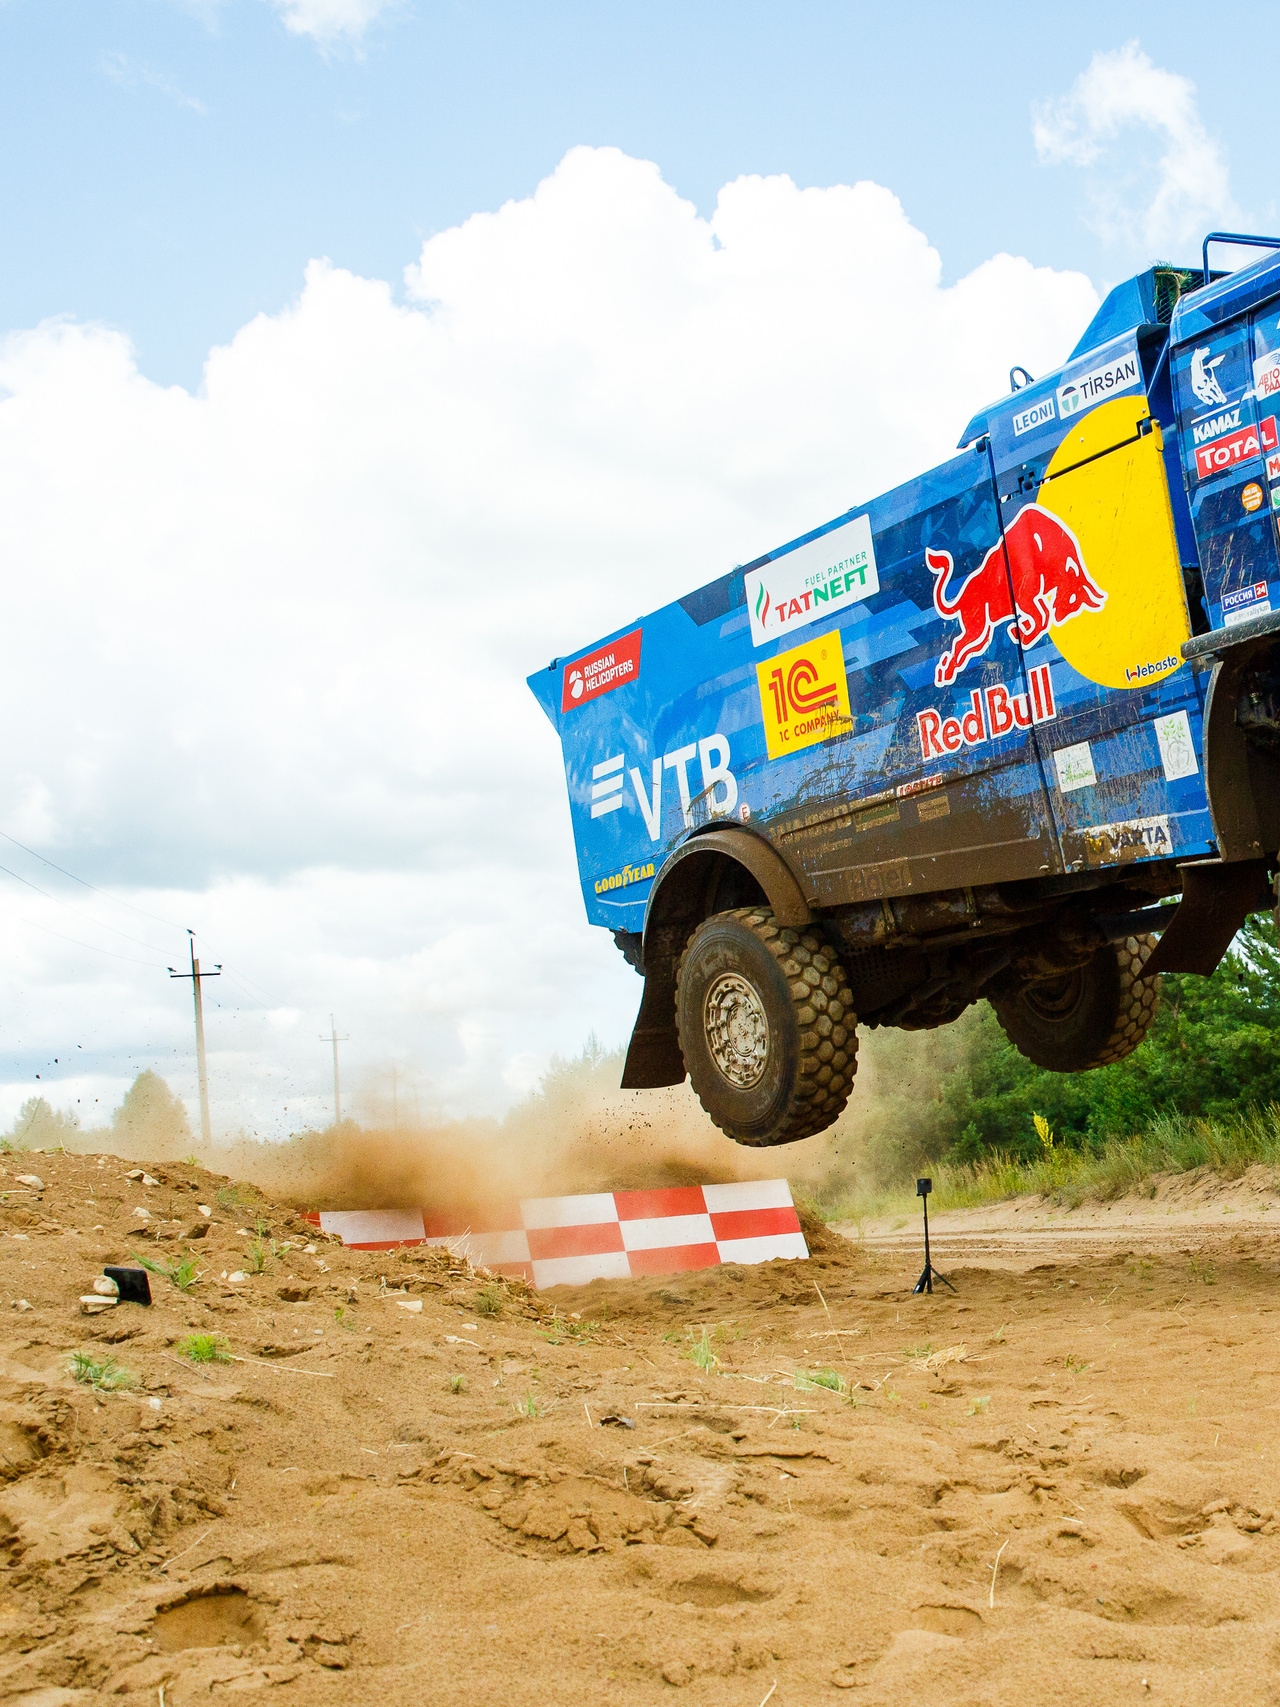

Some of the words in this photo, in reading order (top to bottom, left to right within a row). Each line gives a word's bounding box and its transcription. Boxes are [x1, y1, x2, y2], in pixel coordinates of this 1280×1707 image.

[1015, 401, 1053, 433] LEONI
[1193, 409, 1242, 444] KAMAZ
[1199, 430, 1274, 470] TOTAL
[805, 571, 826, 588] FUEL
[827, 551, 867, 577] PARTNER
[775, 564, 868, 623] TATNEFT
[1224, 590, 1253, 607] РОССИЯ
[1256, 585, 1266, 595] 24
[584, 653, 616, 678] RUSSIAN
[586, 659, 634, 692] HELICOPTERS
[1126, 655, 1178, 683] Webasto
[794, 709, 840, 737] COMPANY
[630, 733, 739, 842] VTB
[594, 862, 655, 895] GOODYEAR
